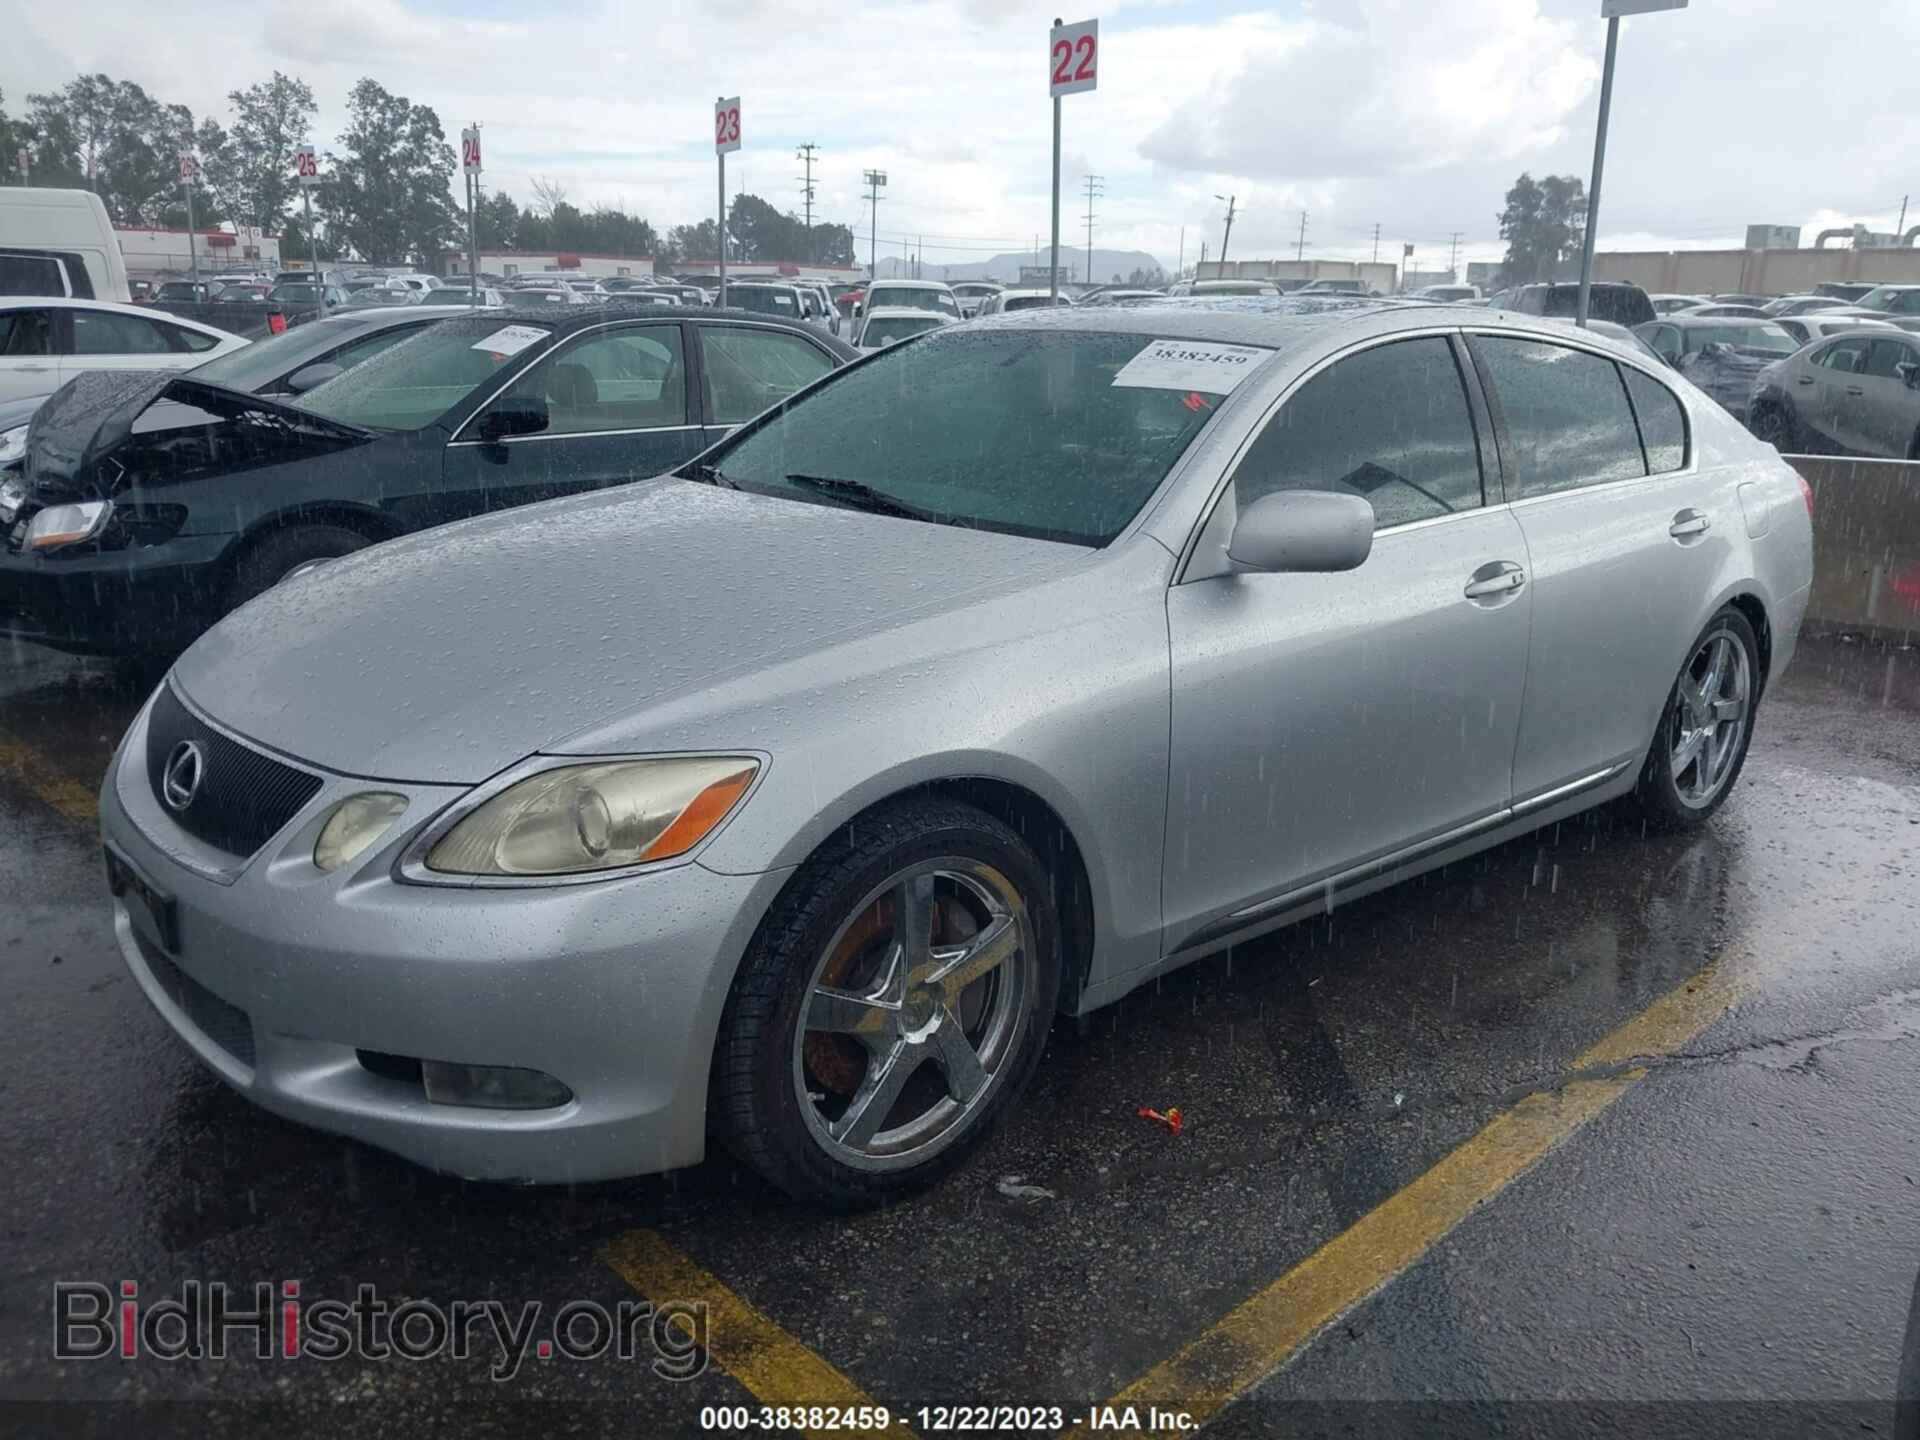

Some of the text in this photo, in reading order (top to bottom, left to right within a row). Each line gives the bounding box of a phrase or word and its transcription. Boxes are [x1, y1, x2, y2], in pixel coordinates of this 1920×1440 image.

[1053, 35, 1095, 84] 22
[716, 108, 740, 144] 23
[298, 153, 316, 176] 25
[463, 138, 480, 167] 24
[1155, 349, 1248, 364] 38382459
